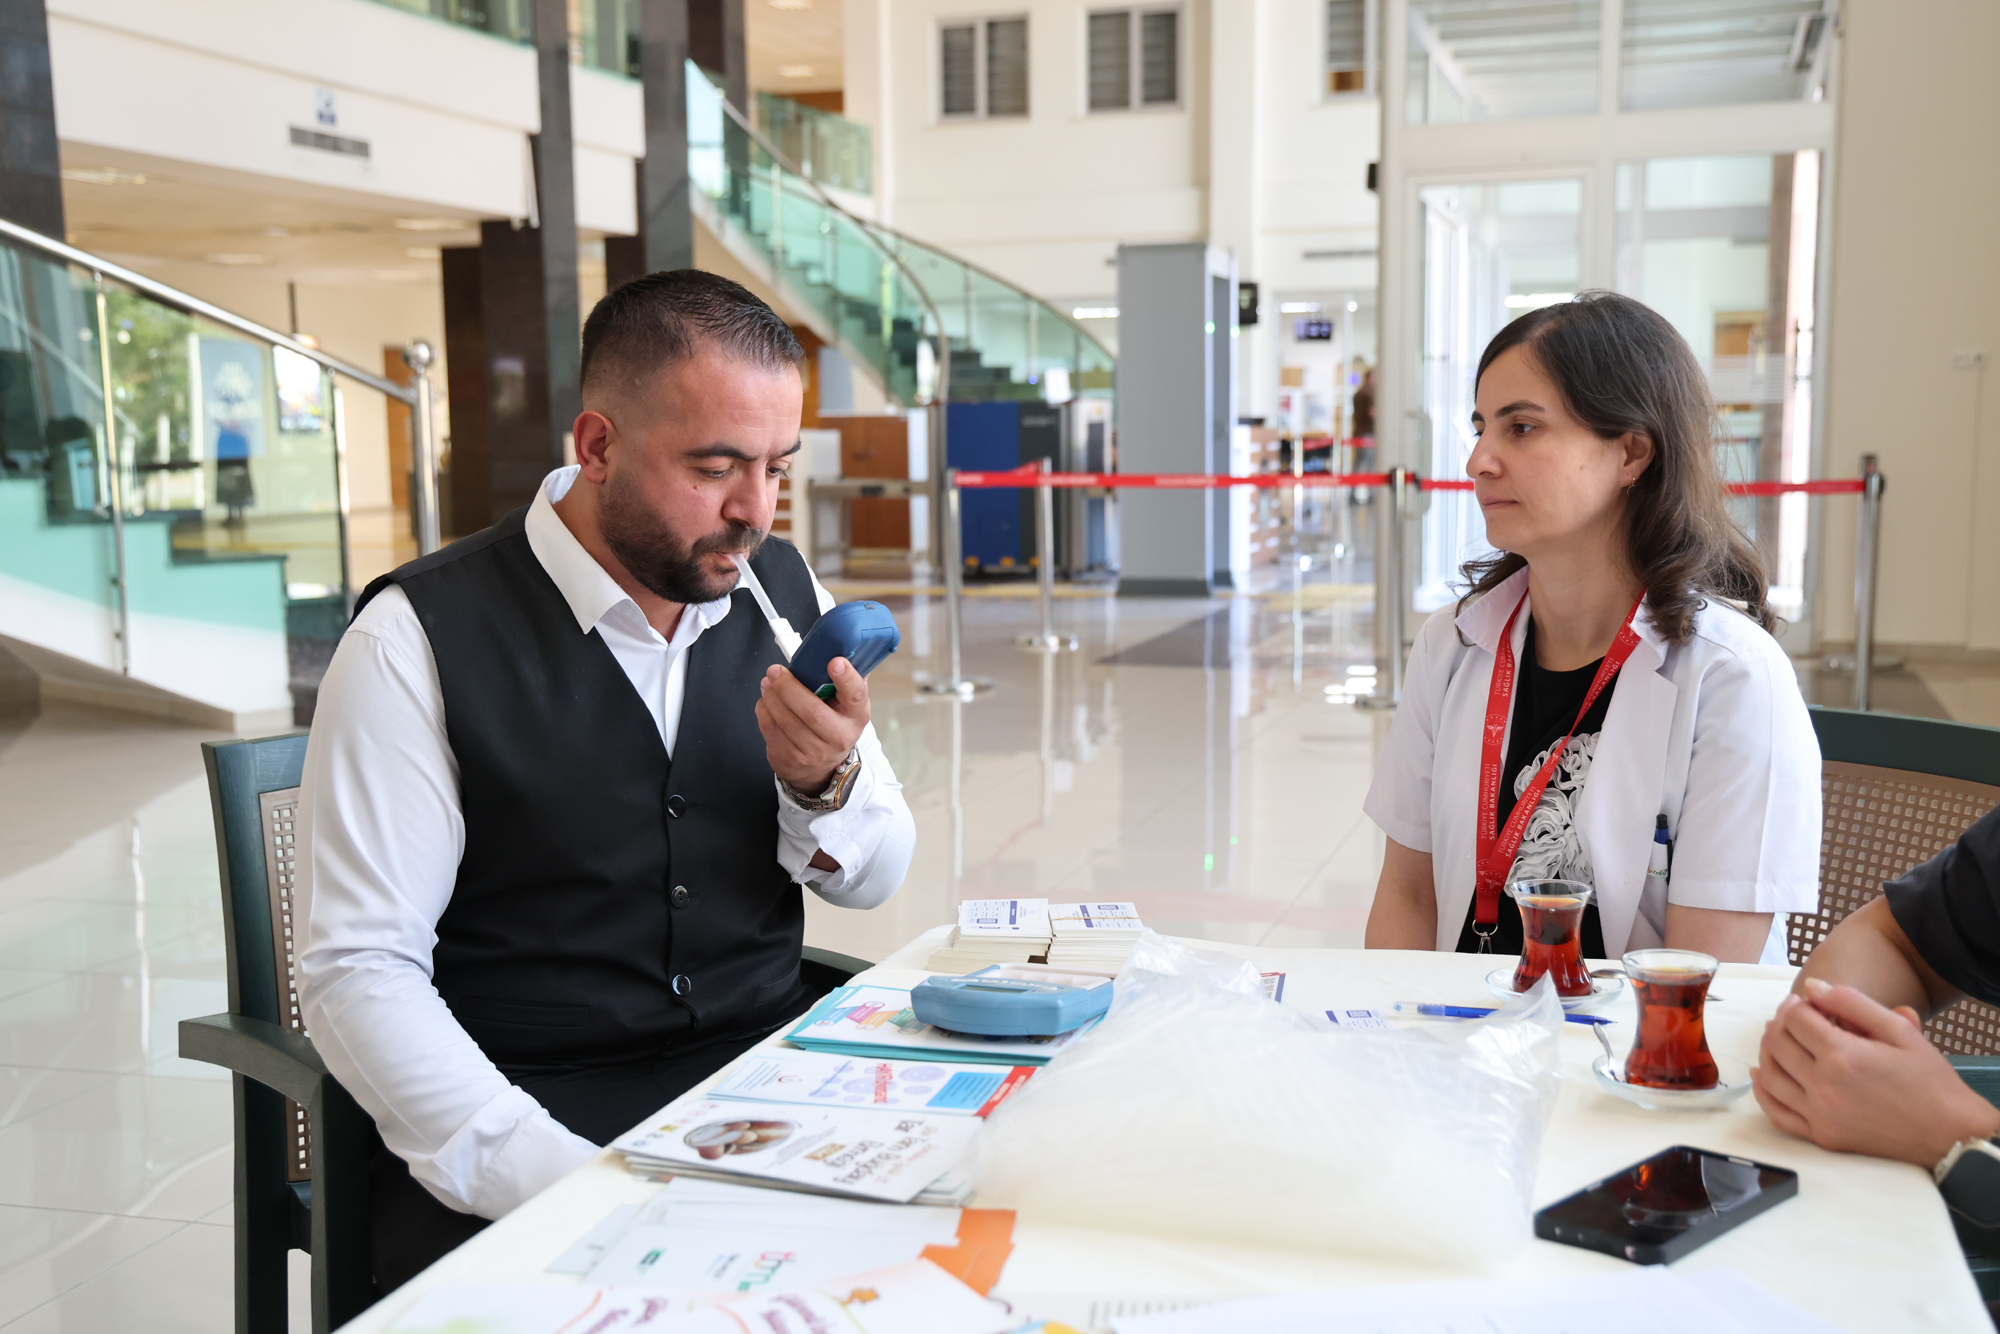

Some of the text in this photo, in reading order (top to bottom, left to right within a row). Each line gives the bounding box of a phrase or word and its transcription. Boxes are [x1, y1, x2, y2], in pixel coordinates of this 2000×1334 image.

[1488, 764, 1498, 840] SAĞLIK BAKANLIĞI
[1505, 789, 1541, 859] SAĞLIK BAKANLIĞI
